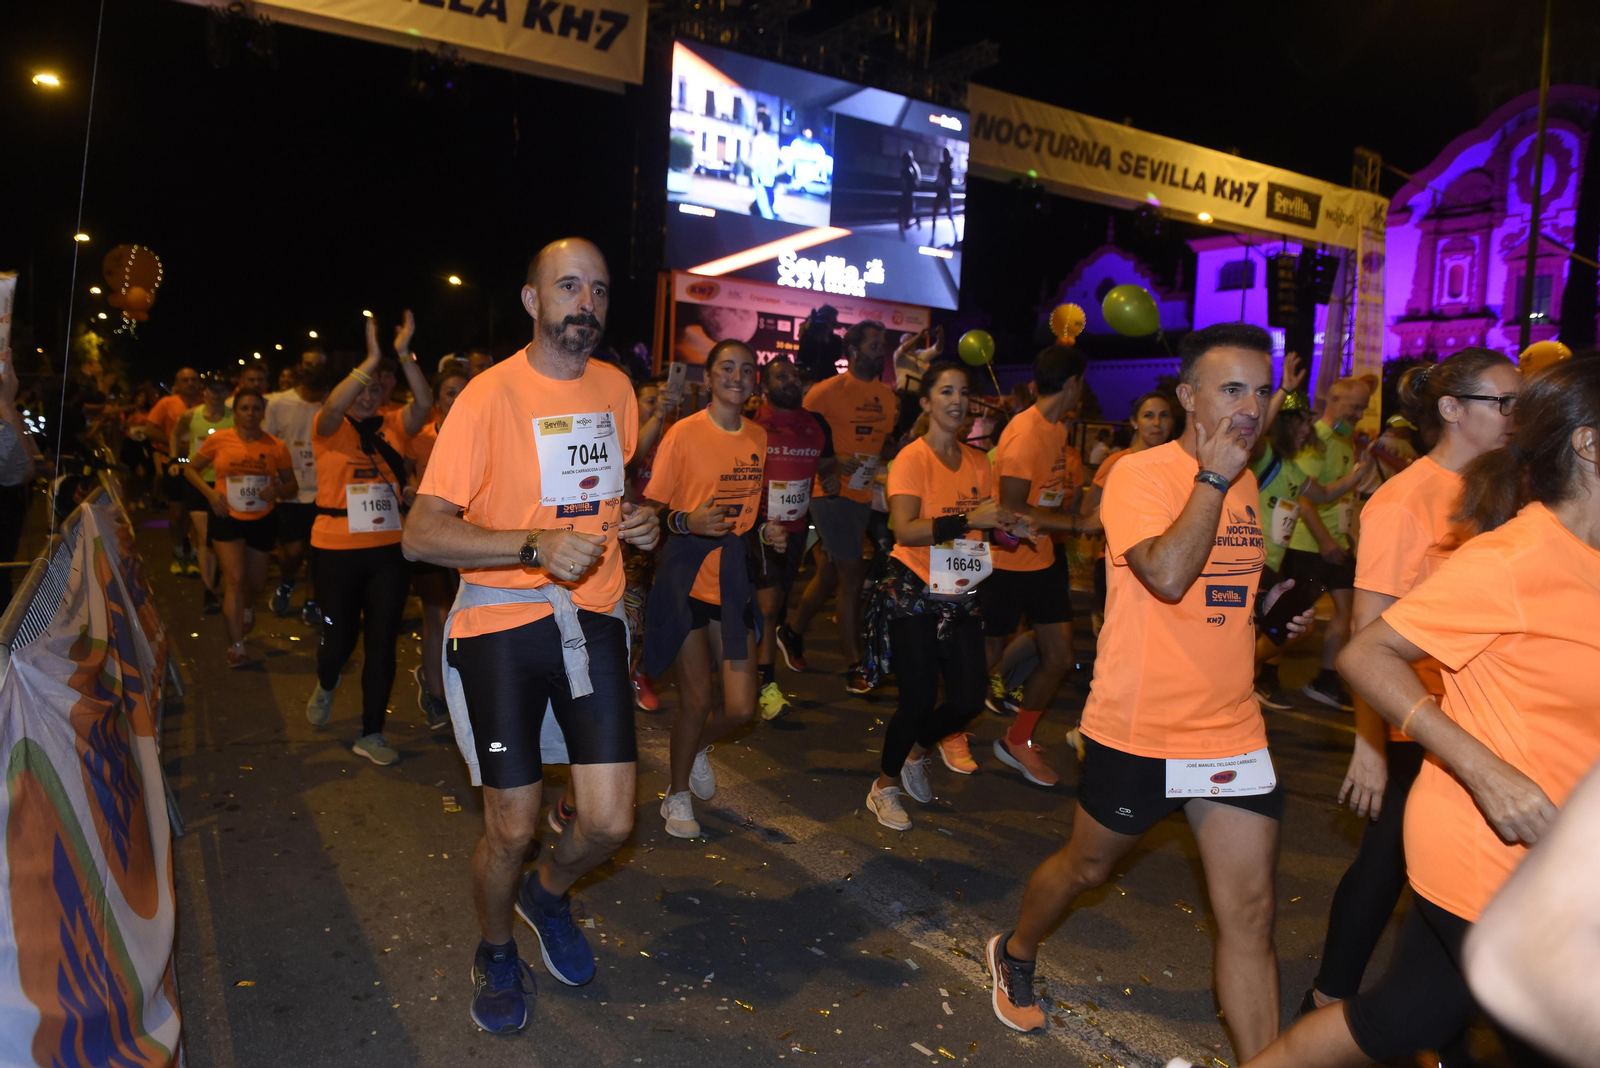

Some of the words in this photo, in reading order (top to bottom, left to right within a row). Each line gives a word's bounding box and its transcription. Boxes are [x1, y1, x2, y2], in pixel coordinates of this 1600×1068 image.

[973, 112, 1112, 171] NOCTURNA
[1118, 150, 1207, 195] SEVILLA
[567, 442, 608, 467] 7044
[719, 474, 747, 482] SEVILLA
[780, 493, 806, 505] 14032
[945, 557, 982, 572] 16649
[1237, 758, 1257, 766] CARRASCO
